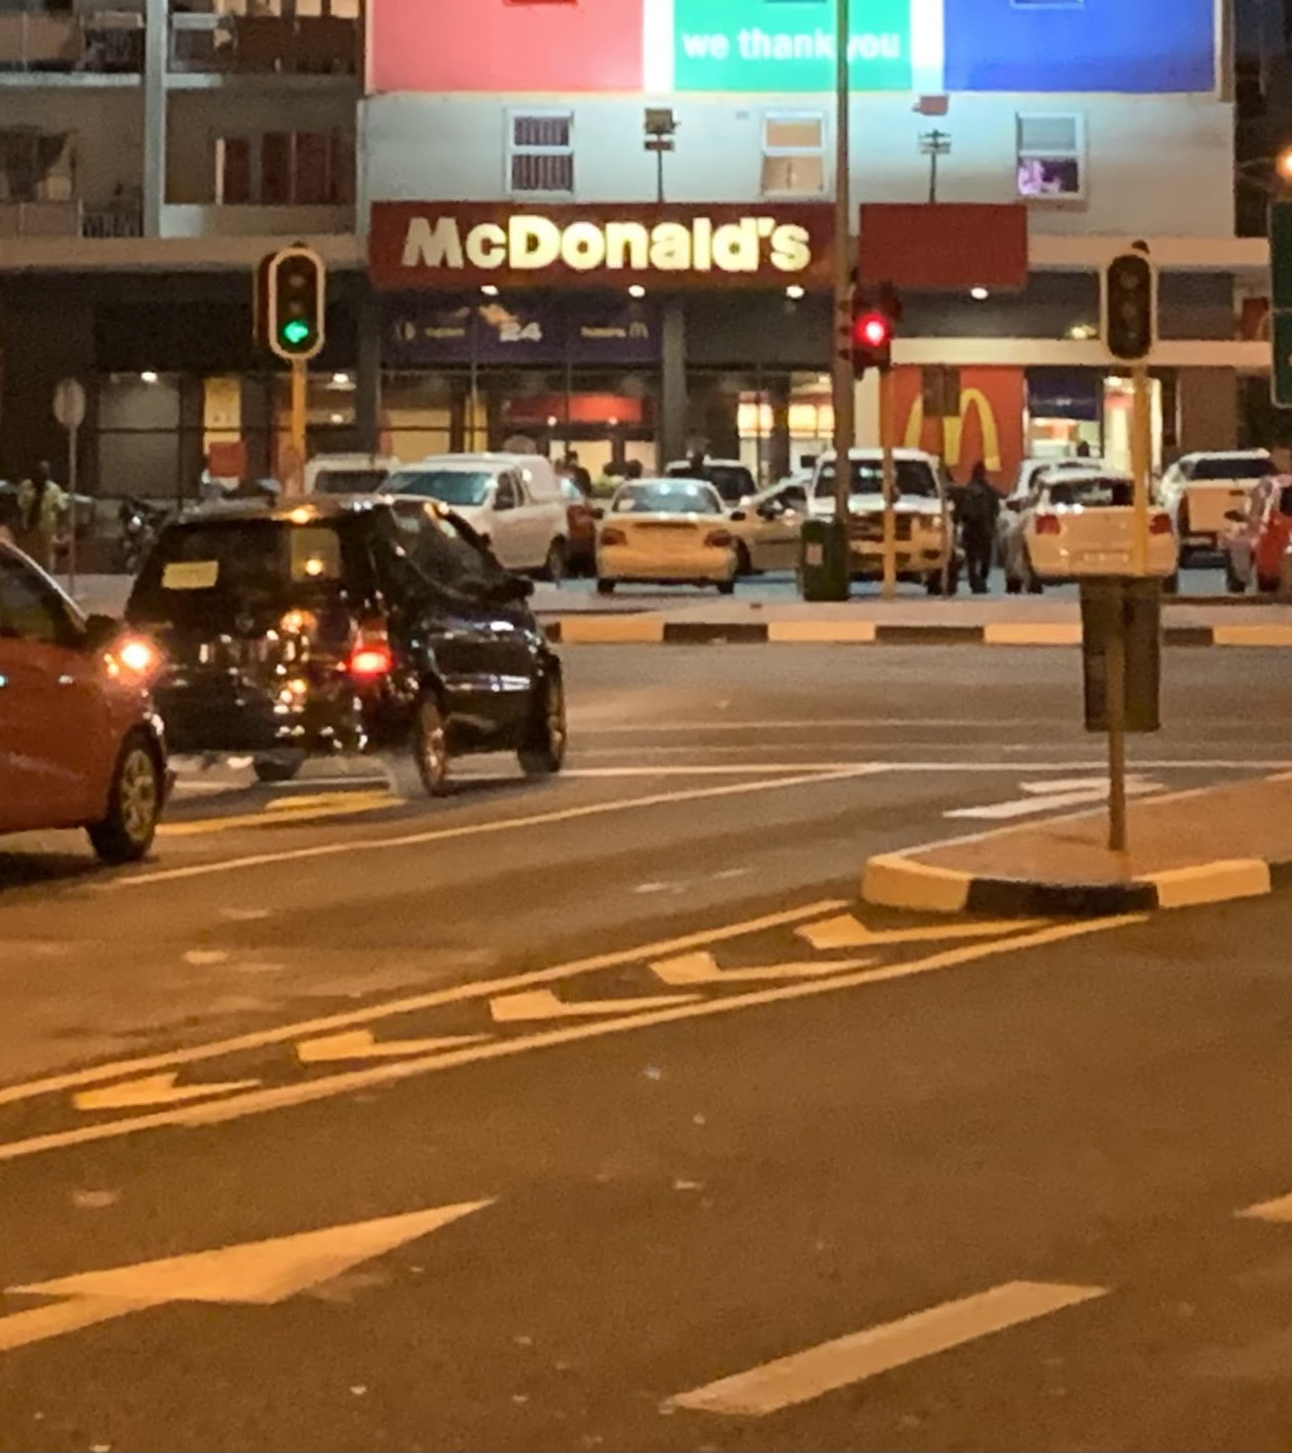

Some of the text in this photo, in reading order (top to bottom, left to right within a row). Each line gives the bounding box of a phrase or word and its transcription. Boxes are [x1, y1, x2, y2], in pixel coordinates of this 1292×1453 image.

[683, 33, 729, 59] we
[737, 25, 836, 60] thank
[402, 215, 811, 271] McDonald's
